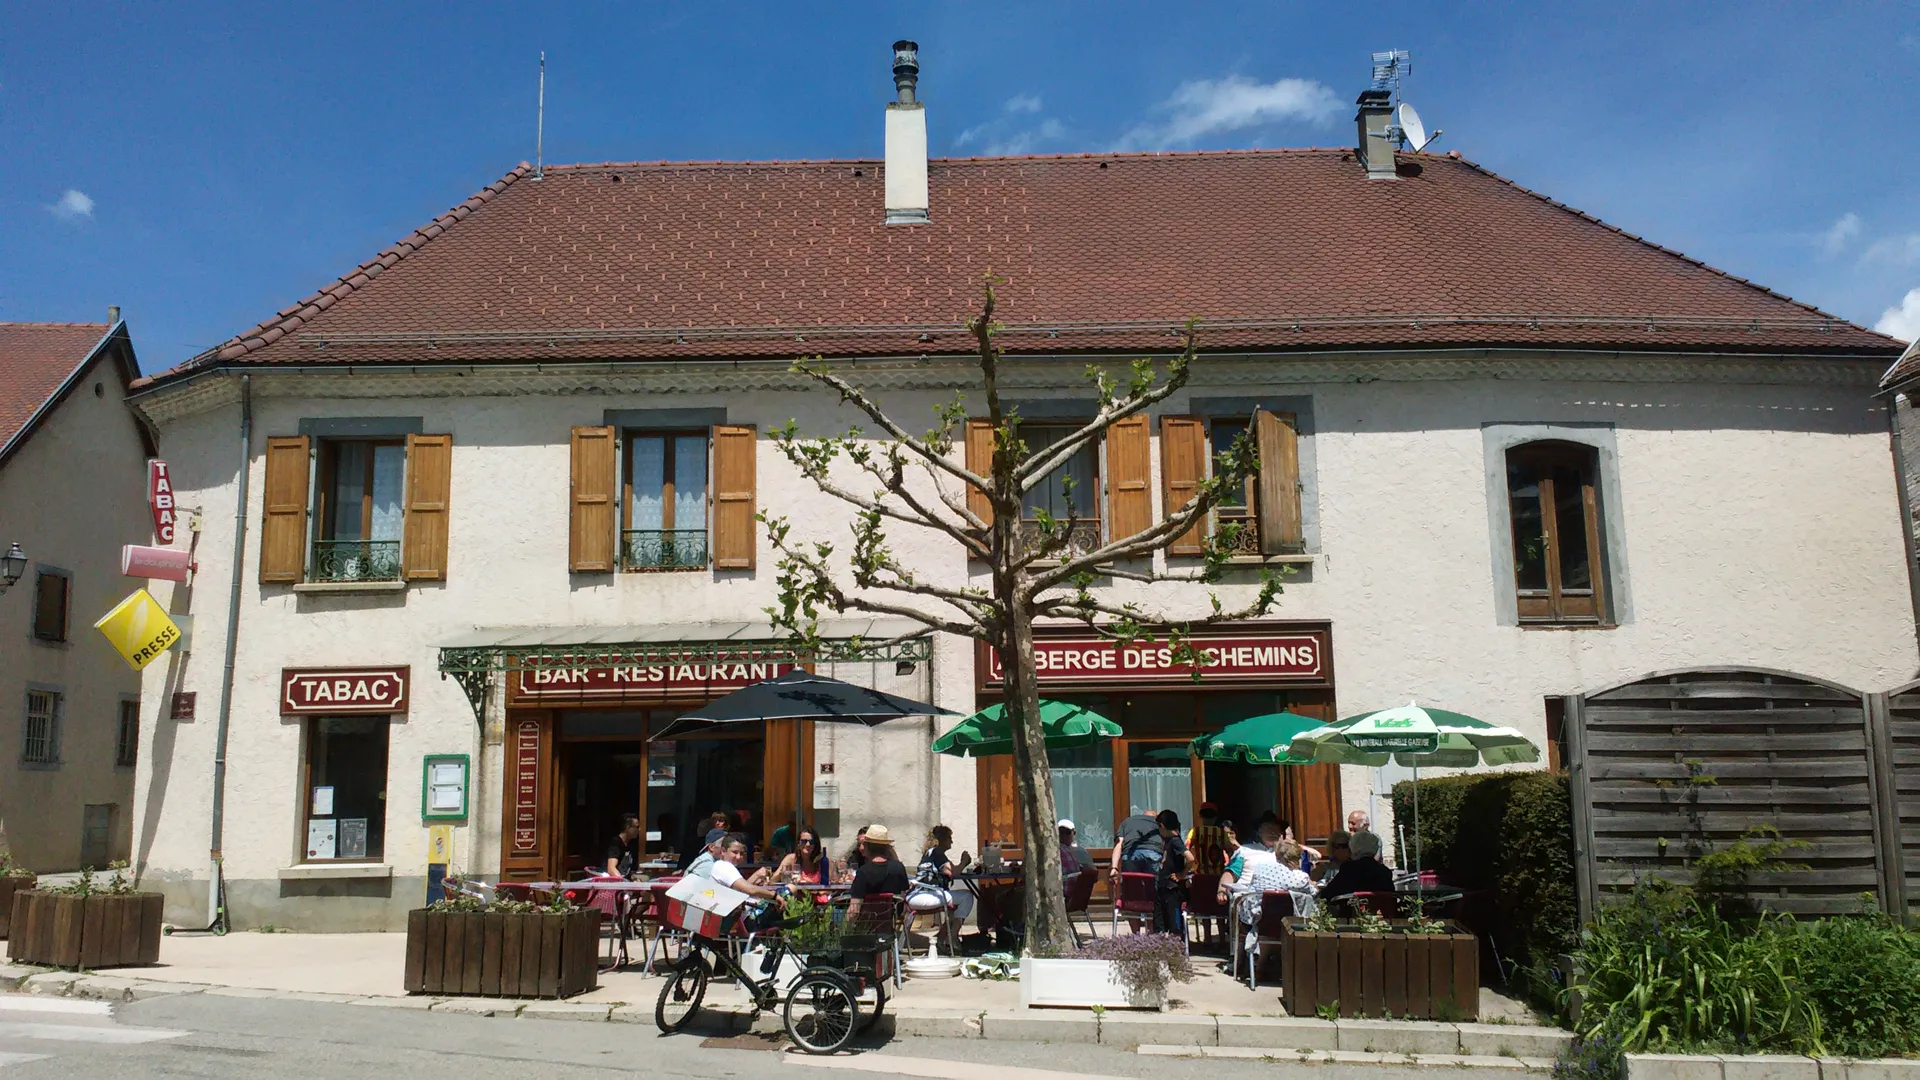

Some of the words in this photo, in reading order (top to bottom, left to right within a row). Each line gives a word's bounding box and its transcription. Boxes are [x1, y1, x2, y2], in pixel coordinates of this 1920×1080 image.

[156, 463, 173, 540] TABAC
[133, 626, 176, 665] PRESSE
[996, 650, 1116, 671] BERGE
[1123, 649, 1172, 669] DES
[1204, 646, 1314, 668] CHEMINS
[535, 667, 589, 683] BAR
[613, 663, 778, 682] RESTAURANT
[301, 680, 389, 701] TABAC
